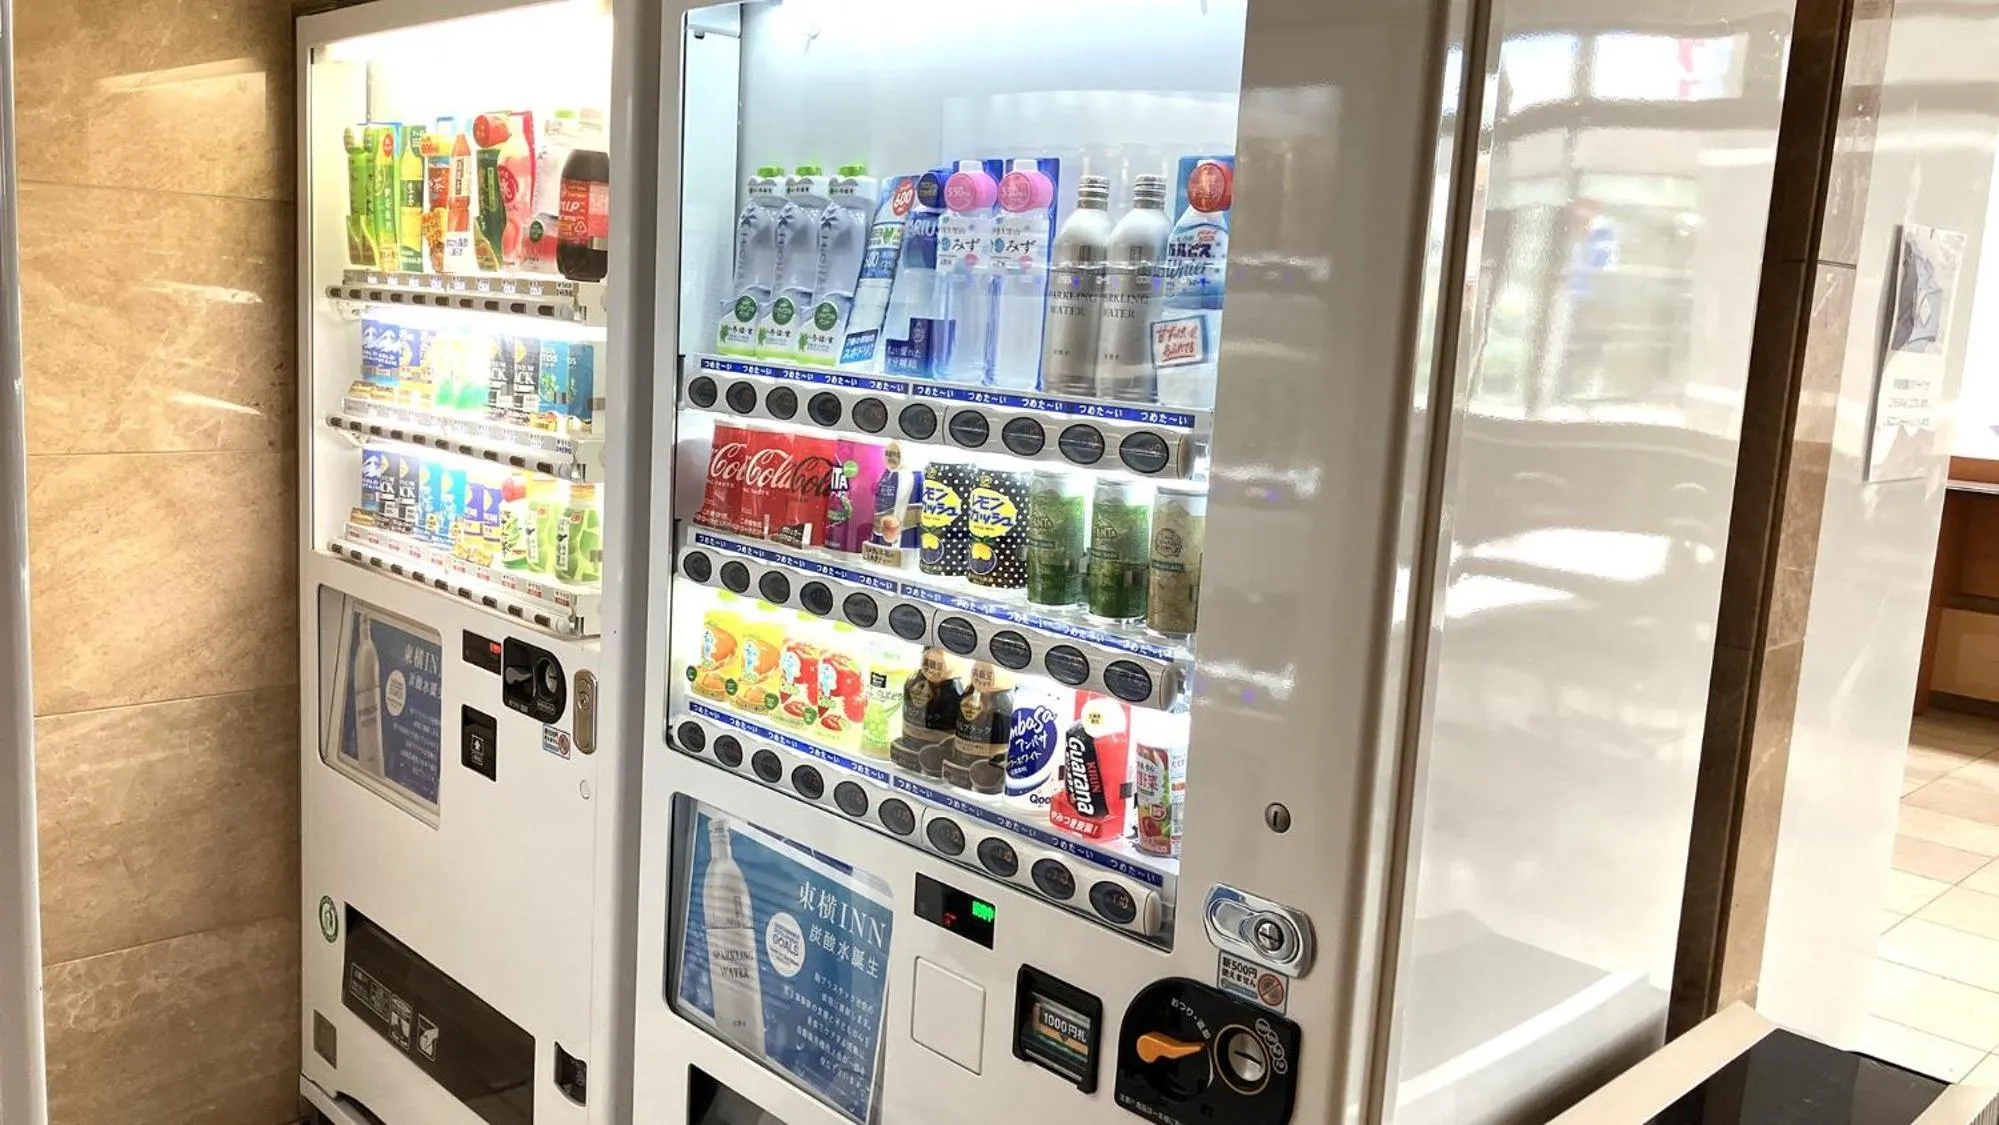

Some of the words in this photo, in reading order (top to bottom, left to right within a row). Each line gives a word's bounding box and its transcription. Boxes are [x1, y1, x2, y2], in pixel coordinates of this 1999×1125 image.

[1015, 730, 1048, 752] アンバサ
[1068, 736, 1095, 816] Guarana
[1086, 761, 1101, 793] KIRIN
[800, 881, 886, 949] 東横INN
[809, 923, 879, 979] 炭酸水誕生
[1221, 967, 1257, 988] 使えません
[1222, 956, 1258, 979] 新500円
[1043, 1011, 1087, 1043] 1000円札
